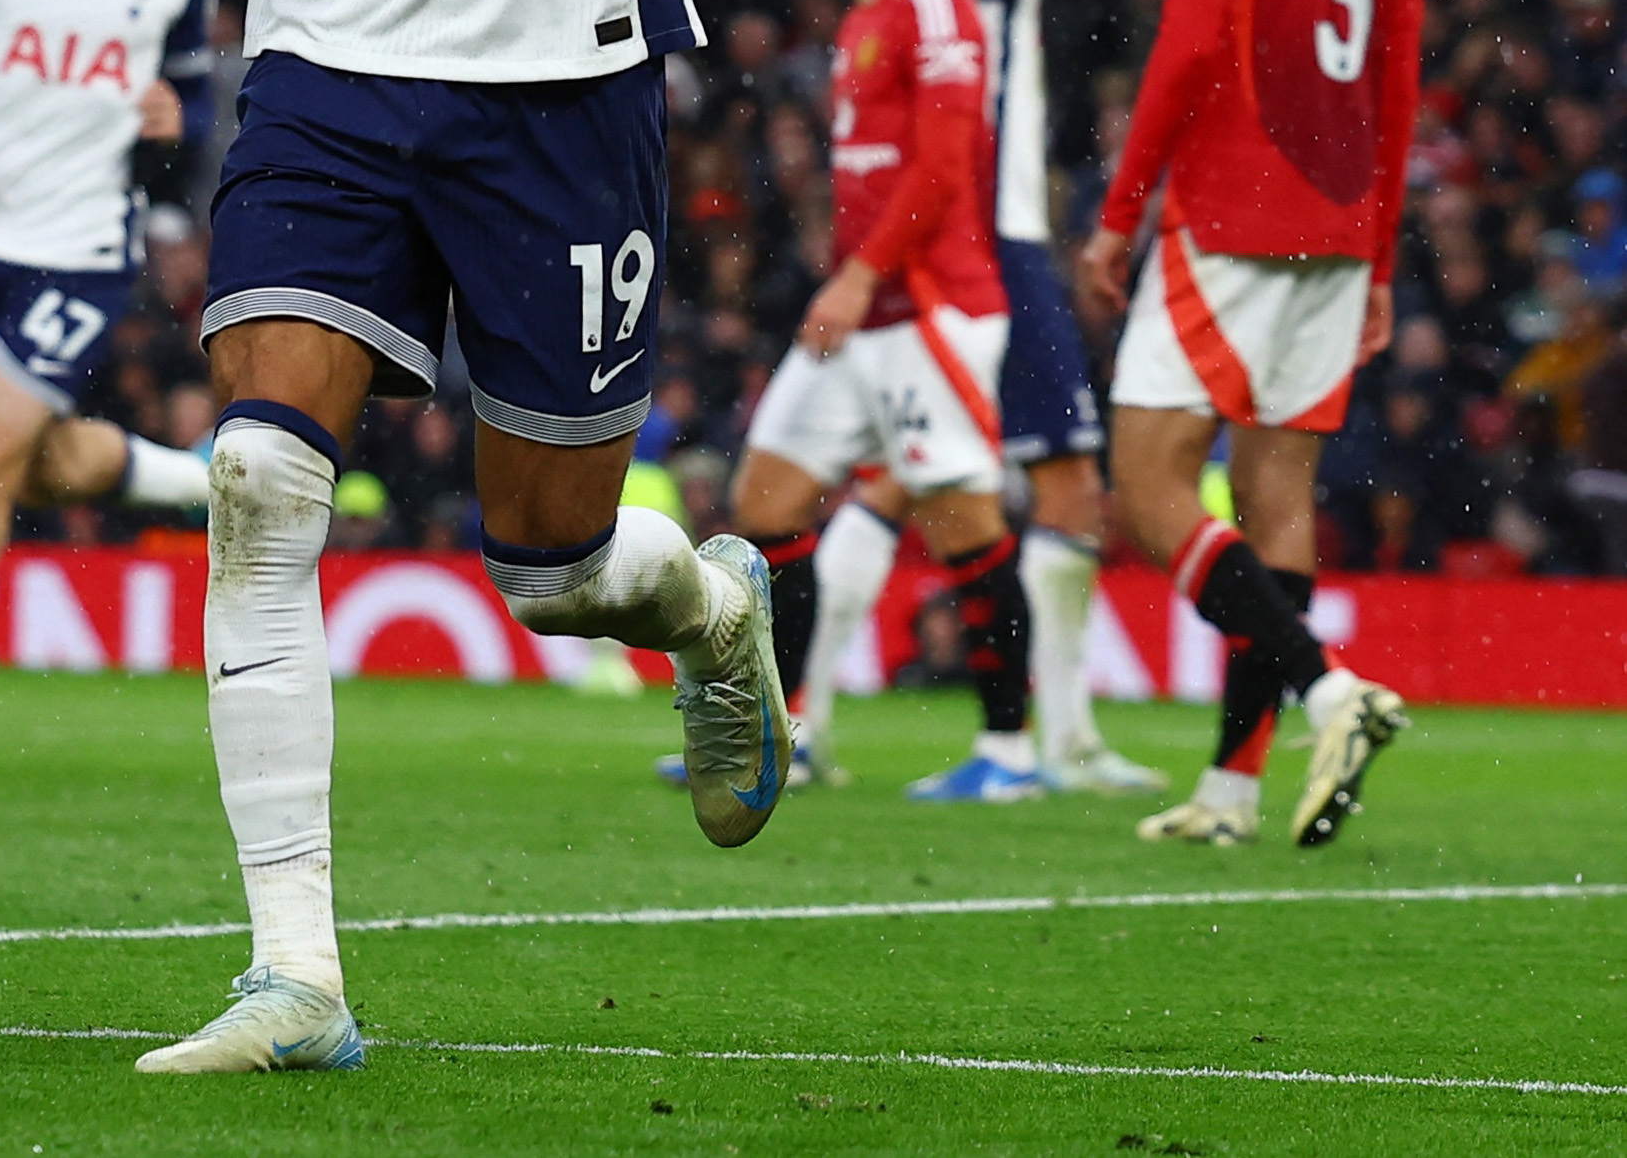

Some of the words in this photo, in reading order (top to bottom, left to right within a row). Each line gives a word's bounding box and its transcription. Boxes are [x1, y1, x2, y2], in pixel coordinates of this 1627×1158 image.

[1, 24, 131, 93] AIA
[20, 287, 107, 362] 47
[569, 228, 656, 353] 19
